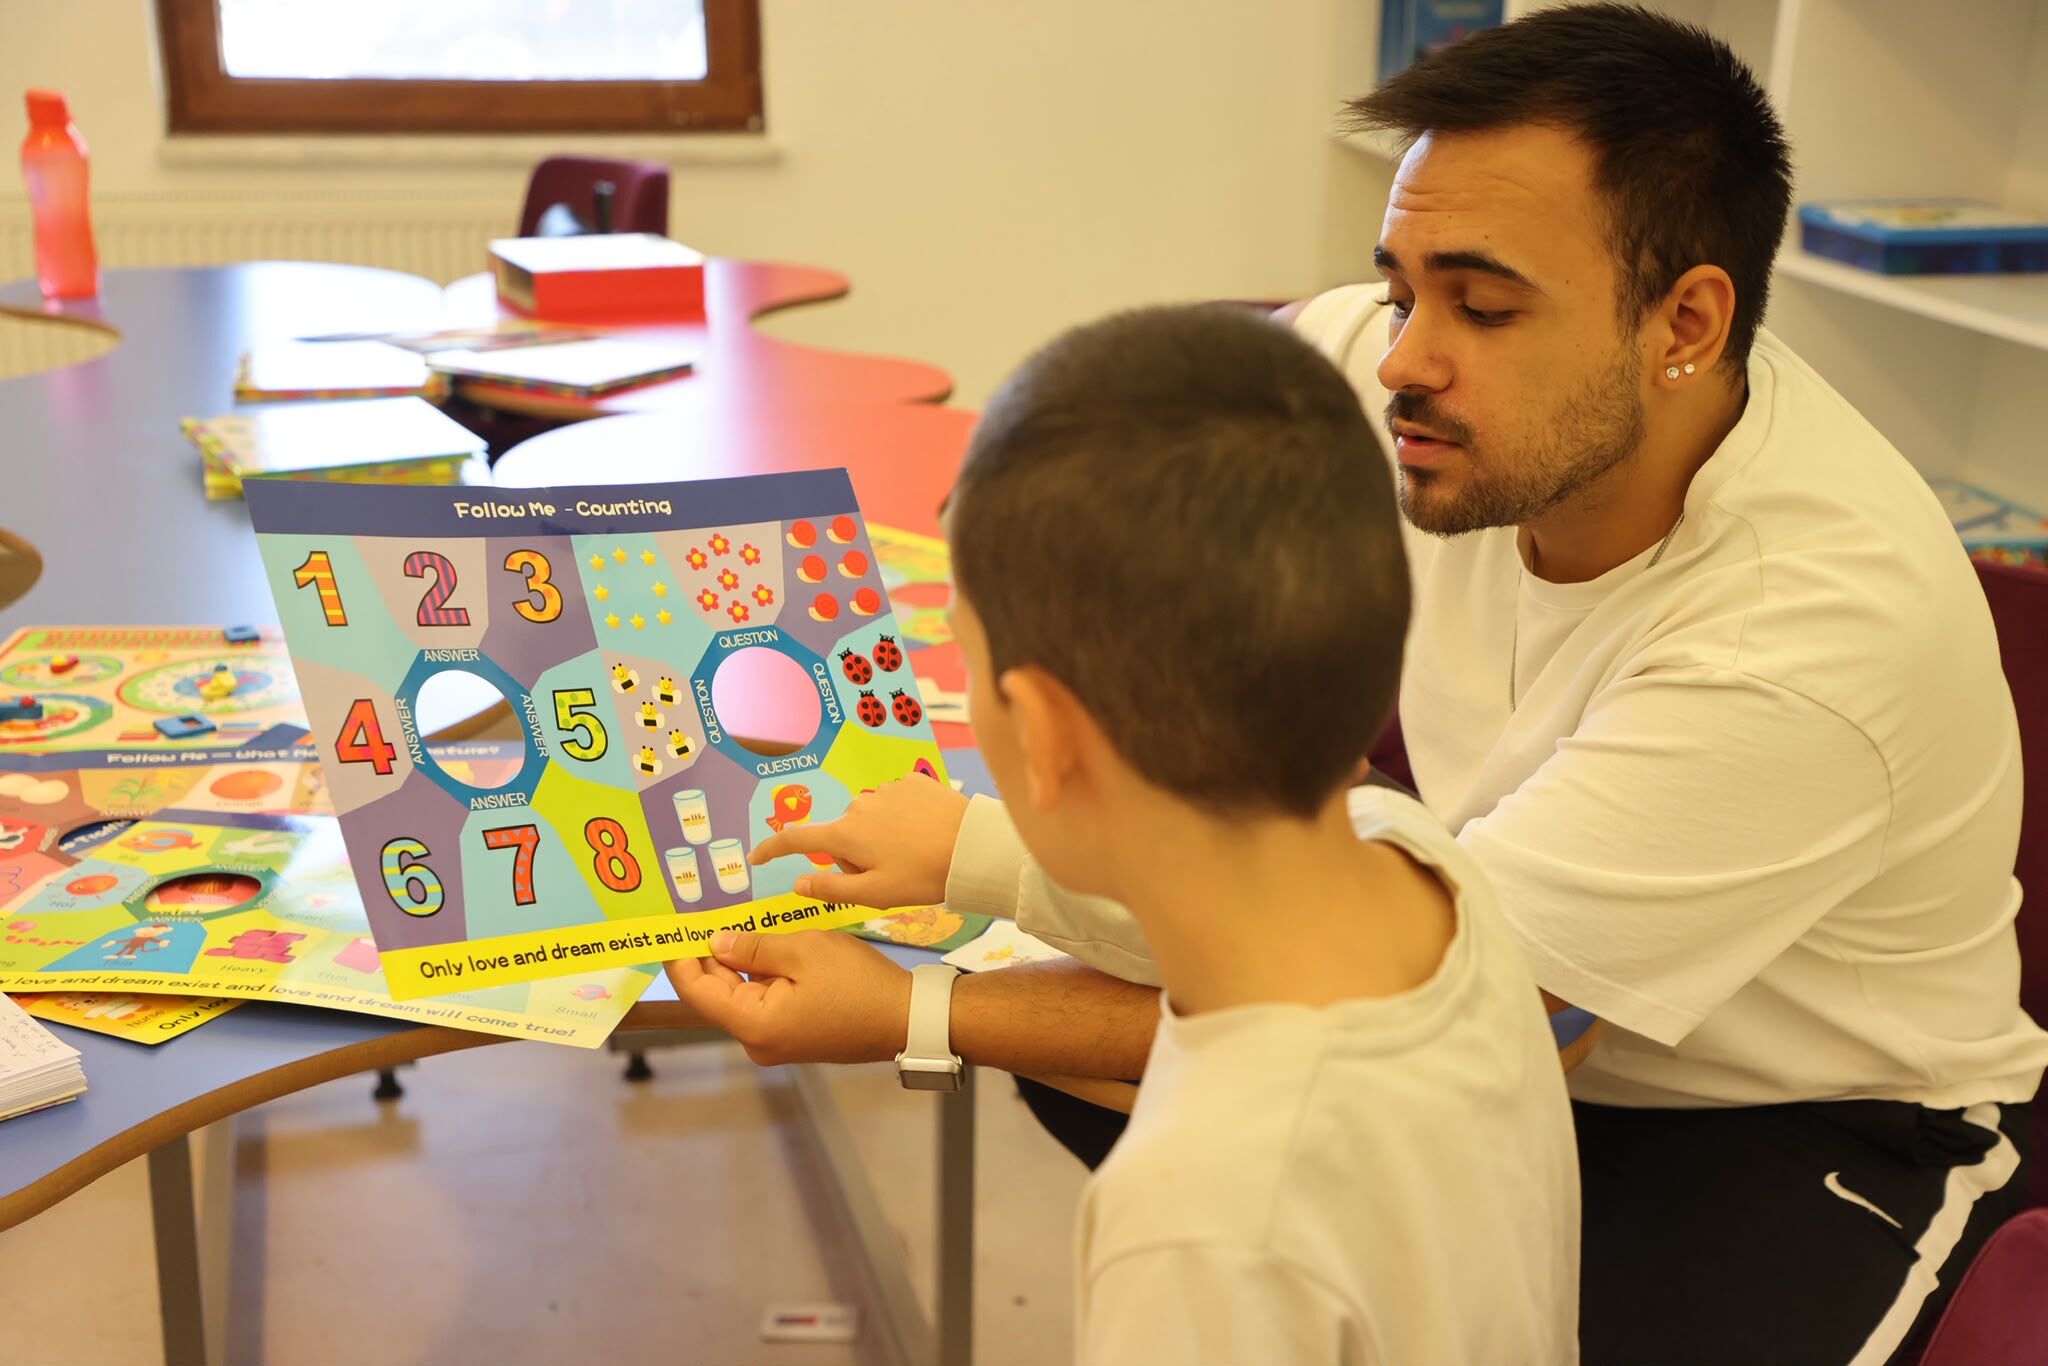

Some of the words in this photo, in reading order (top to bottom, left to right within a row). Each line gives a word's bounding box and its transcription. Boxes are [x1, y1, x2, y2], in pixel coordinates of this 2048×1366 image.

[454, 501, 526, 519] Follow
[528, 500, 556, 517] Me
[293, 551, 348, 627] 1
[404, 551, 471, 626] 2
[504, 549, 564, 624] 3
[424, 649, 480, 663] ANSWER
[718, 630, 779, 649] QUESTION
[519, 693, 549, 759] ANSWER
[552, 688, 608, 762] 5
[693, 679, 722, 744] QUESTION
[811, 662, 843, 724] QUESTION
[107, 752, 176, 764] Follow
[335, 699, 397, 776] 4
[395, 698, 426, 766] ANSWER
[756, 753, 819, 777] QUESTION
[470, 792, 529, 811] ANSWER
[380, 837, 445, 917] 6
[482, 824, 540, 906] 7
[584, 817, 642, 893] 8
[420, 961, 463, 979] Only
[468, 953, 509, 973] love
[513, 945, 548, 966] and
[551, 935, 605, 961] dream
[608, 932, 652, 951] exist
[655, 928, 683, 947] and
[760, 905, 820, 929] dream
[15, 977, 54, 986] love
[64, 976, 100, 985] and
[102, 976, 164, 986] dream
[168, 979, 221, 990] exist
[225, 984, 266, 993] and
[269, 985, 312, 997] love
[315, 992, 355, 1004] and
[357, 998, 421, 1014] dream
[426, 1009, 462, 1019] will
[466, 1014, 518, 1029] come
[525, 1023, 577, 1038] true!
[158, 1010, 201, 1031] Only
